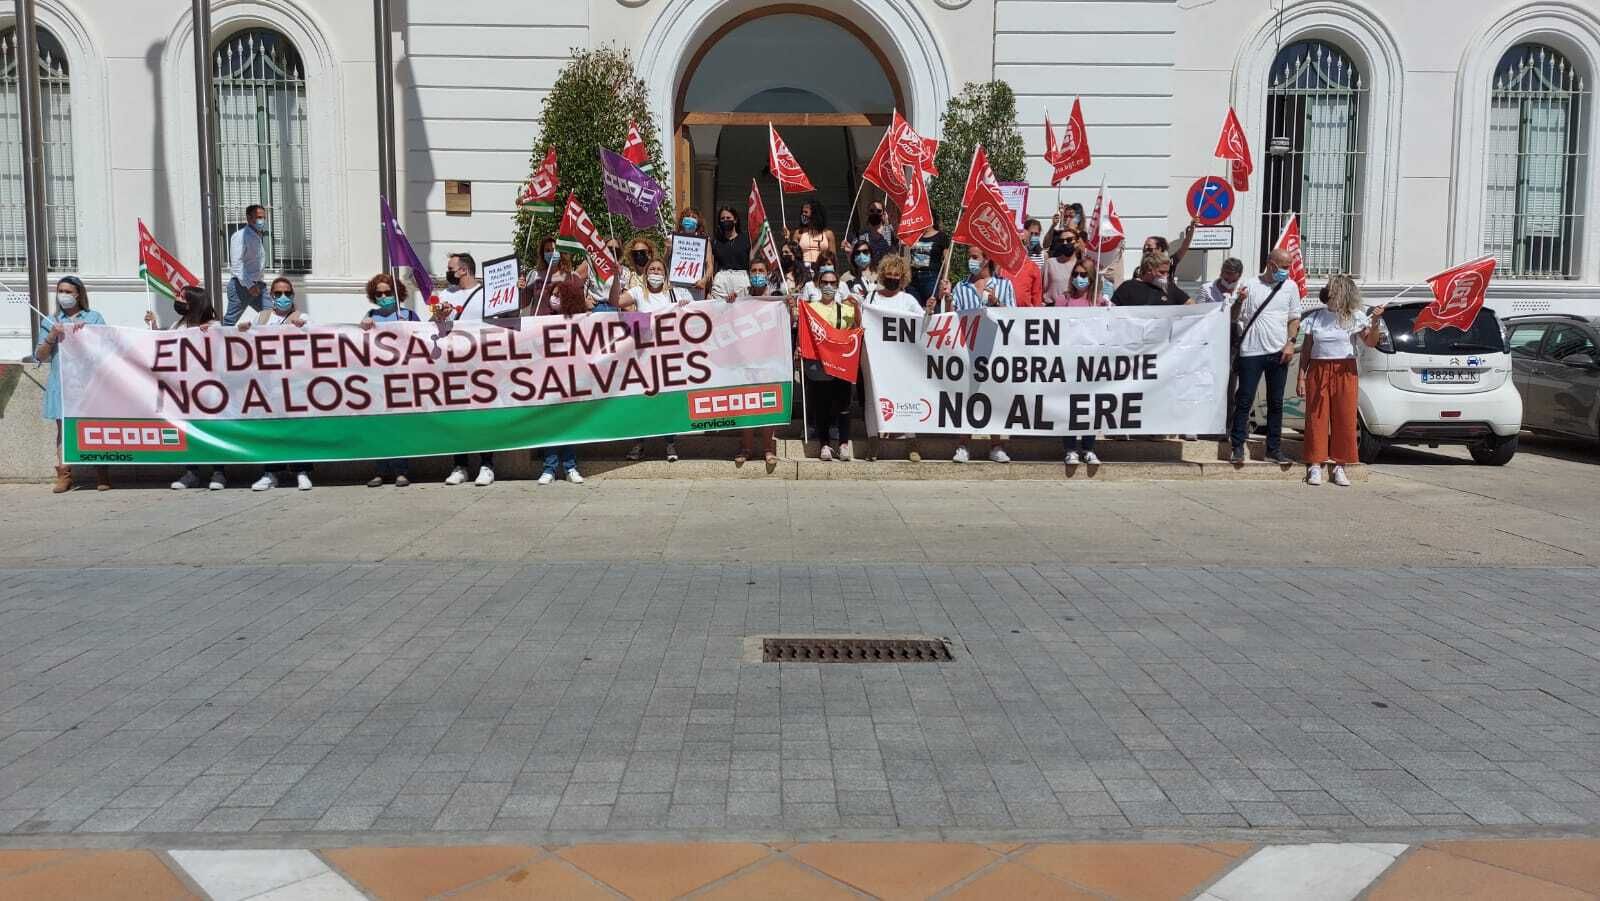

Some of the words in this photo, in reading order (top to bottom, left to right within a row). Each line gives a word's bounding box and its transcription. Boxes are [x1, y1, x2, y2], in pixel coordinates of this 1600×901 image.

[151, 336, 213, 371] EN
[225, 331, 434, 371] DEFENSA
[447, 328, 532, 363] DEL
[542, 311, 712, 358] EMPLEO
[882, 317, 916, 343] EN
[926, 315, 981, 352] H&M
[997, 319, 1015, 345] Y
[1024, 319, 1060, 346] EN
[156, 379, 230, 415] NO
[242, 378, 272, 414] A
[281, 375, 372, 412] LOS
[383, 369, 498, 409] ERES
[511, 351, 712, 401] SALVAJES
[926, 354, 964, 381] NO
[973, 355, 1066, 383] SOBRA
[1076, 354, 1158, 382] NADIE
[694, 393, 761, 414] CCOO
[938, 391, 992, 429] NO
[1004, 394, 1054, 430] AL
[1068, 392, 1143, 431] ERE
[84, 427, 160, 445] CCOO
[691, 418, 737, 429] servicios
[80, 451, 133, 462] servicios
